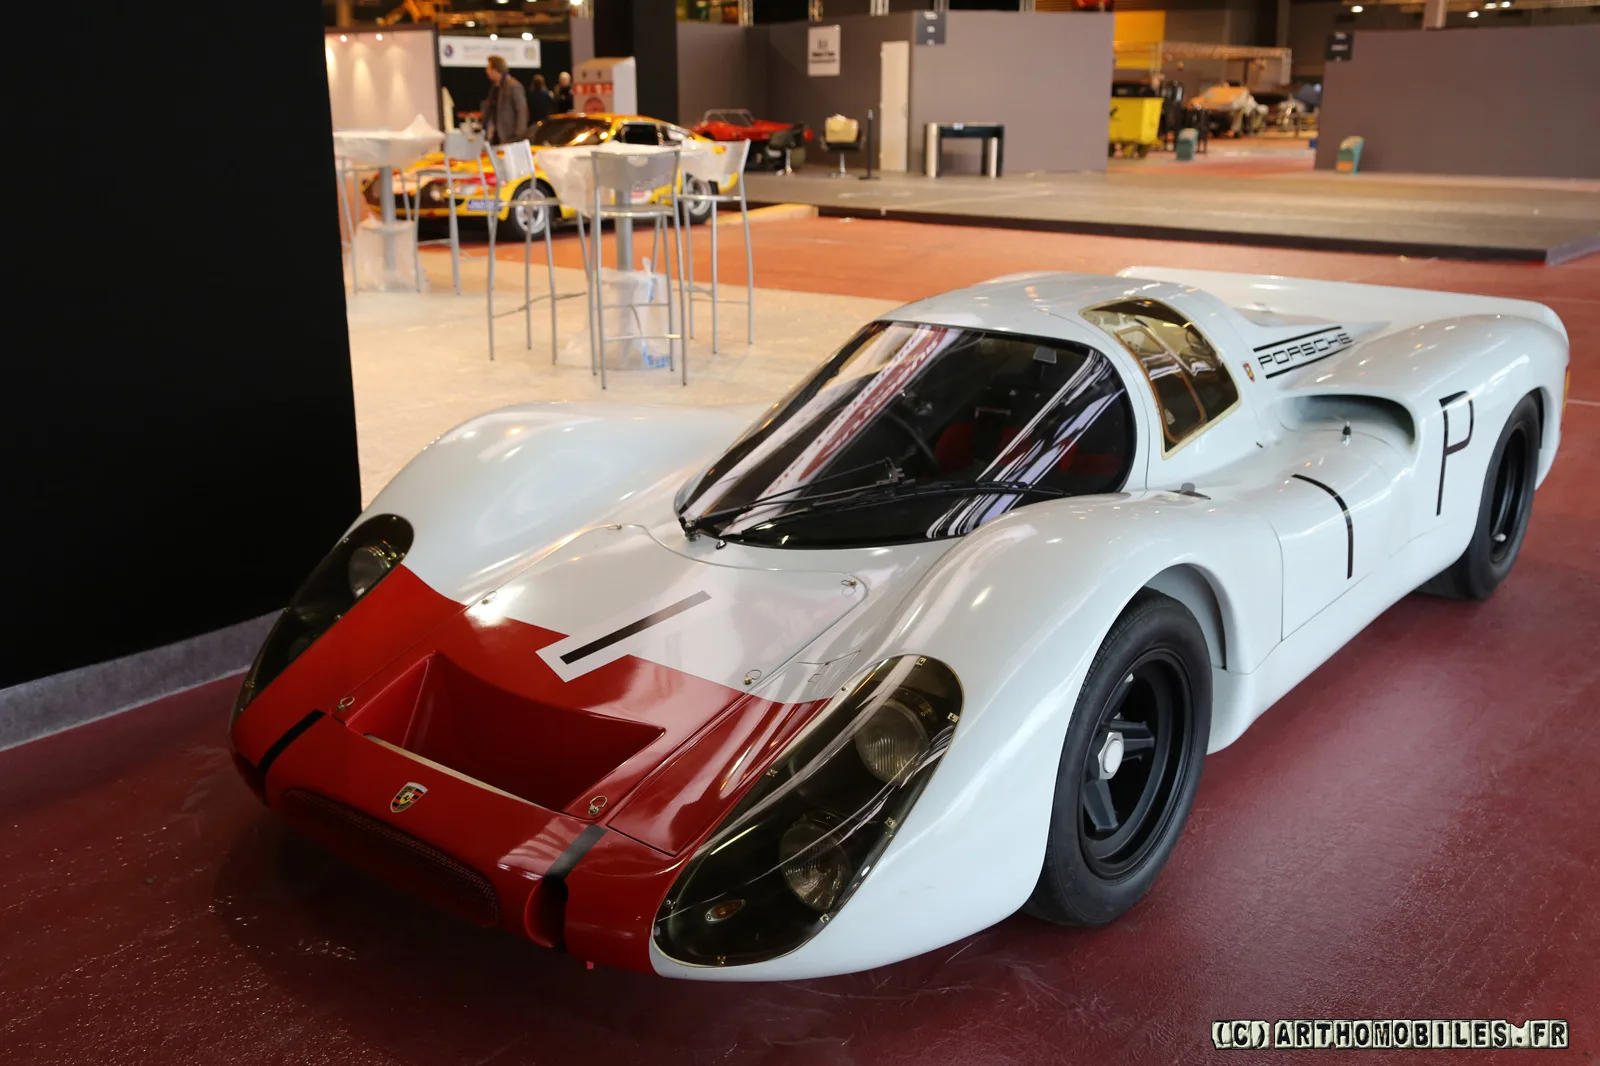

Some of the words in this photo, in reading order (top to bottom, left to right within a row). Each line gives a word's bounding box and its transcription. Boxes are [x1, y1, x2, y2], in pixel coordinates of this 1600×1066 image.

[1257, 332, 1354, 370] PORSCHE
[1436, 390, 1474, 516] P
[559, 590, 712, 665] 1
